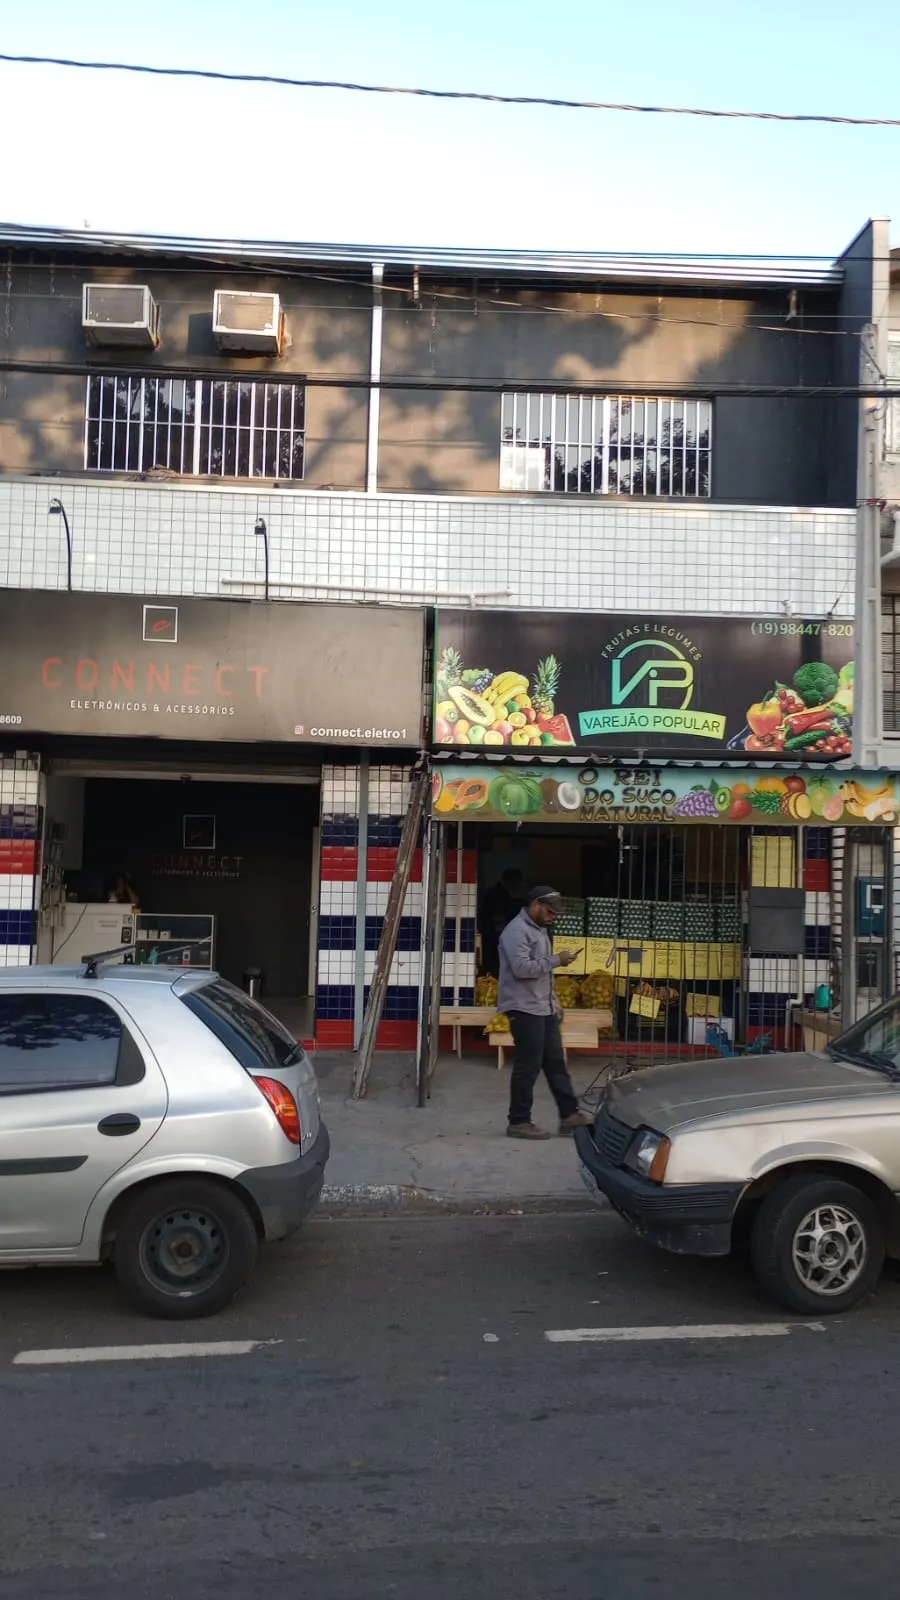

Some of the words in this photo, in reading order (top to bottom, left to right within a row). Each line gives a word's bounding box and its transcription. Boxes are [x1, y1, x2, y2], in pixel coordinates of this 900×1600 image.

[601, 625, 641, 659] FRUTAS
[644, 623, 650, 632] E
[654, 624, 702, 661] LEGUMES
[42, 657, 270, 697] CONNECT
[70, 699, 148, 712] ELETRÔNICOS
[153, 703, 160, 712] &
[166, 703, 235, 716] ACESSÓRIOS
[583, 712, 649, 730] VAREJÃO
[653, 715, 721, 732] POPULAR
[310, 727, 407, 739] connect.eletro1
[578, 768, 599, 785] O
[613, 768, 663, 786] REI
[584, 787, 615, 805] DO
[622, 787, 677, 805] SUCO
[580, 805, 676, 822] NATURAL
